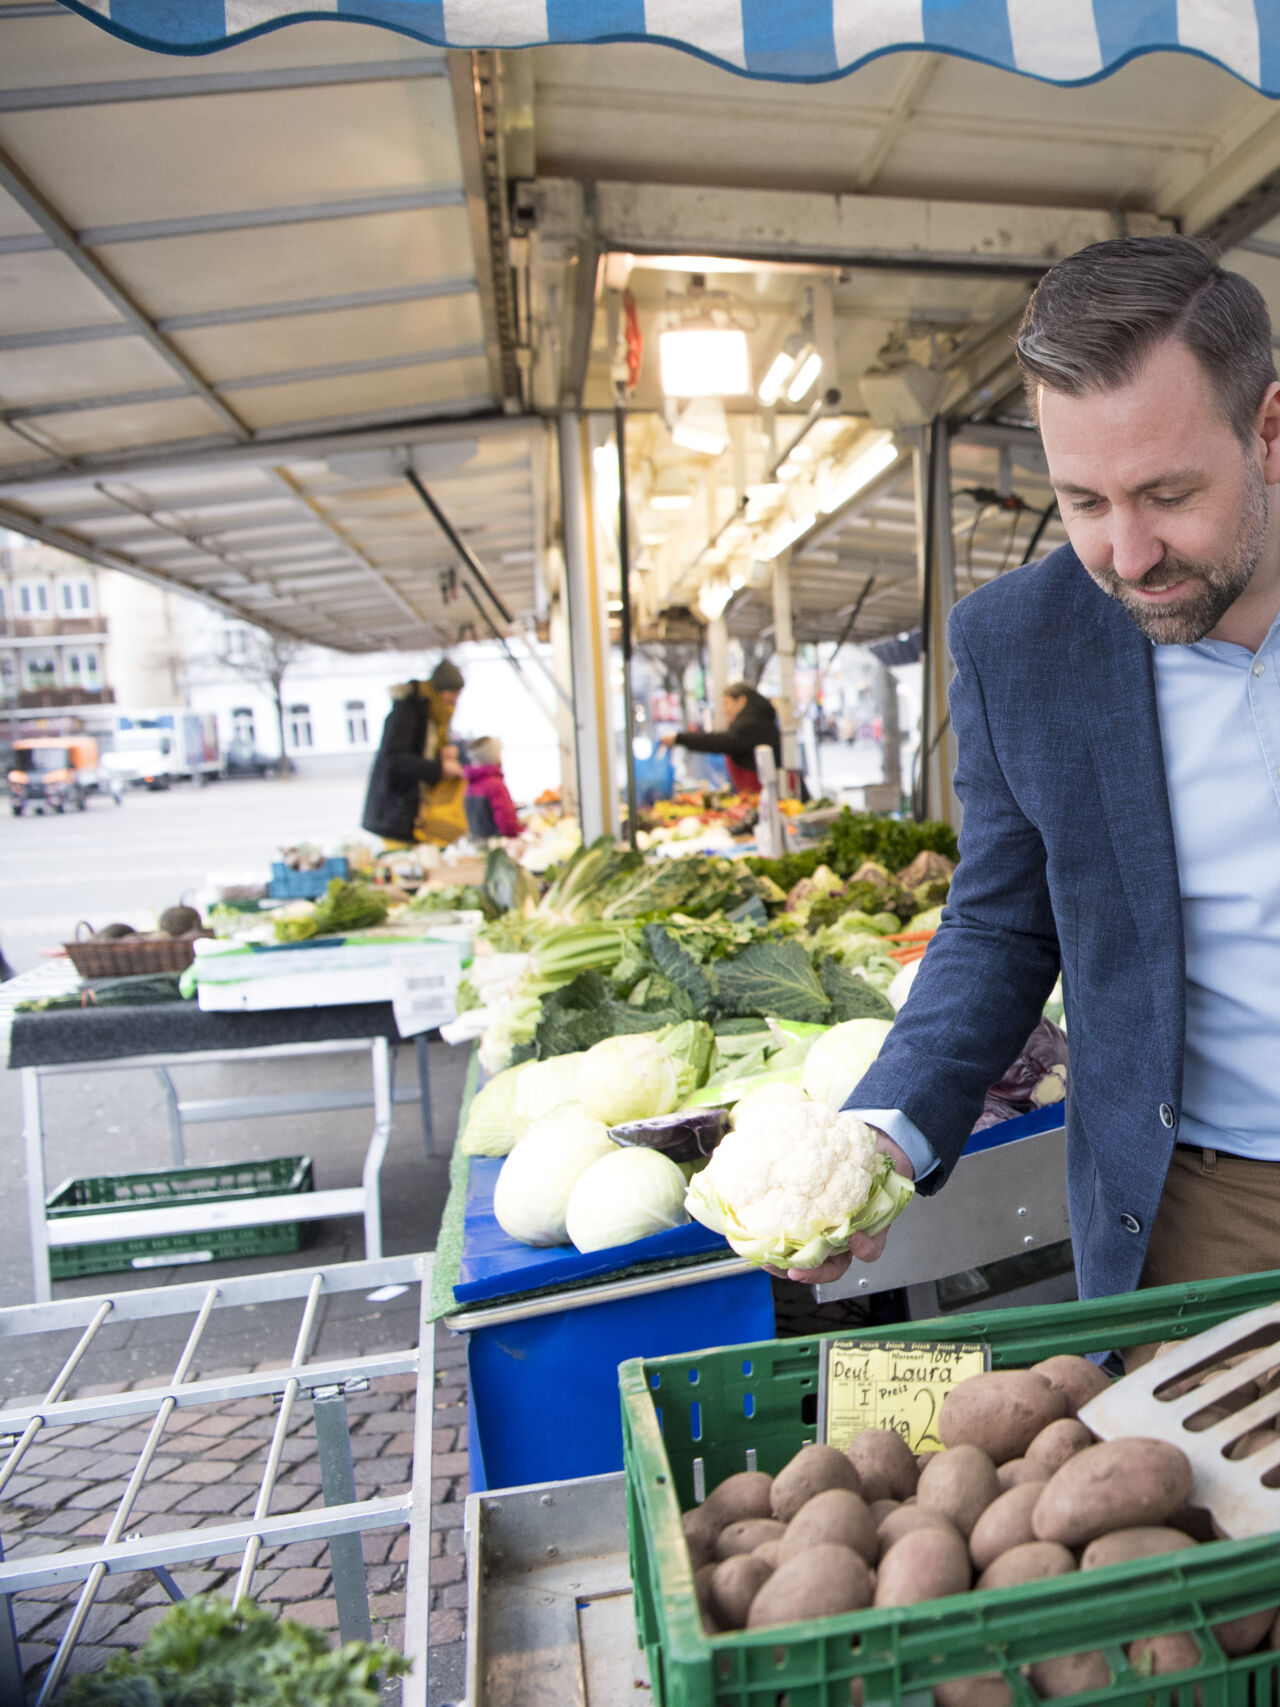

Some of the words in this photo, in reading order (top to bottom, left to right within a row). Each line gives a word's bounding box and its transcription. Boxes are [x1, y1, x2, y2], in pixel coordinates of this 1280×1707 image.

[891, 1361, 952, 1382] Laura
[879, 1385, 908, 1400] Preis
[913, 1388, 949, 1453] 2
